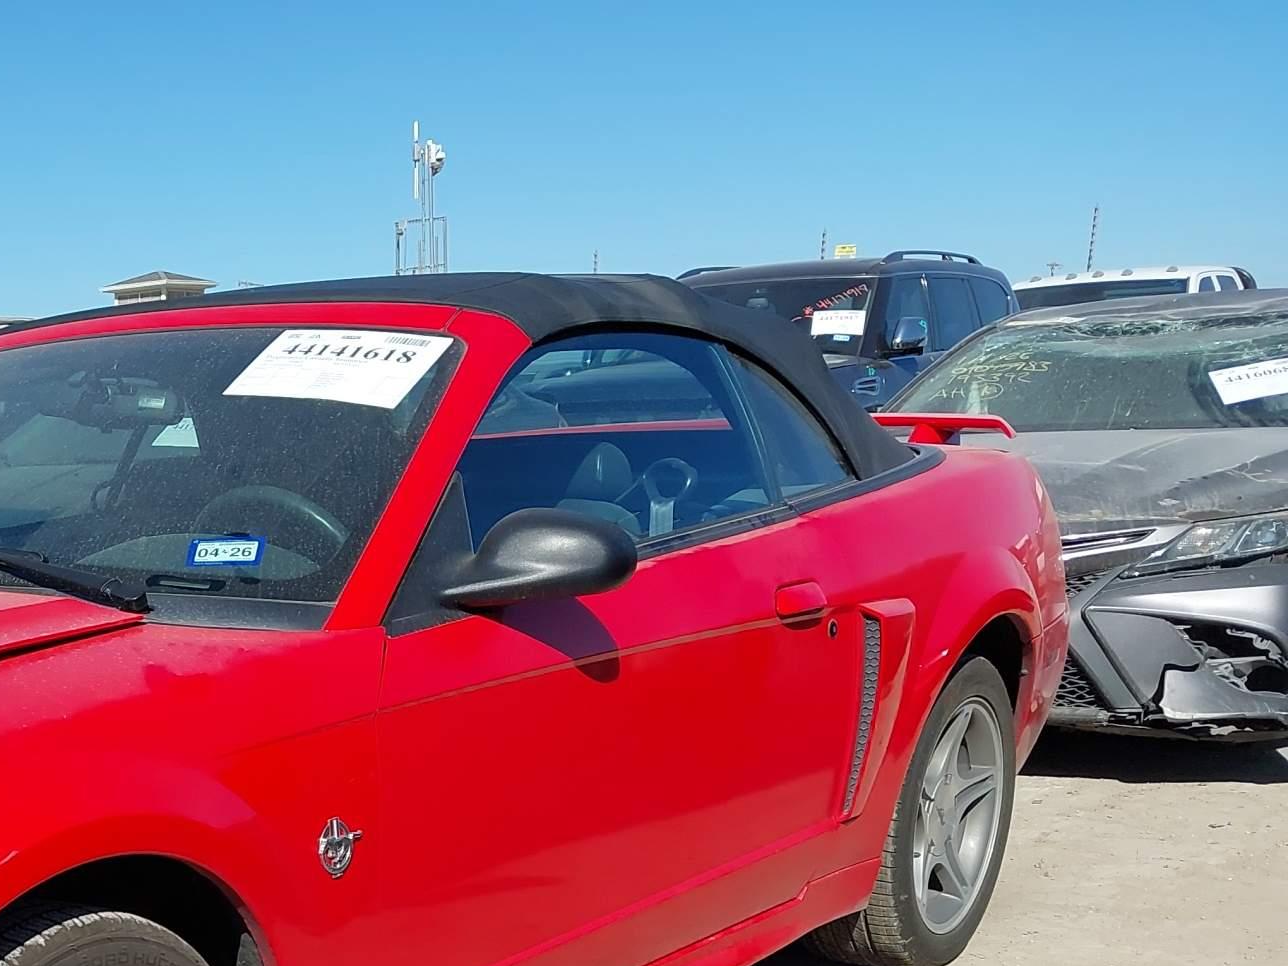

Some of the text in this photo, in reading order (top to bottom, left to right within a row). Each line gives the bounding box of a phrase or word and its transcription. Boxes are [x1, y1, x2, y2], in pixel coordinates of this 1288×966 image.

[283, 343, 417, 364] 44141618
[198, 547, 252, 558] 04 26
